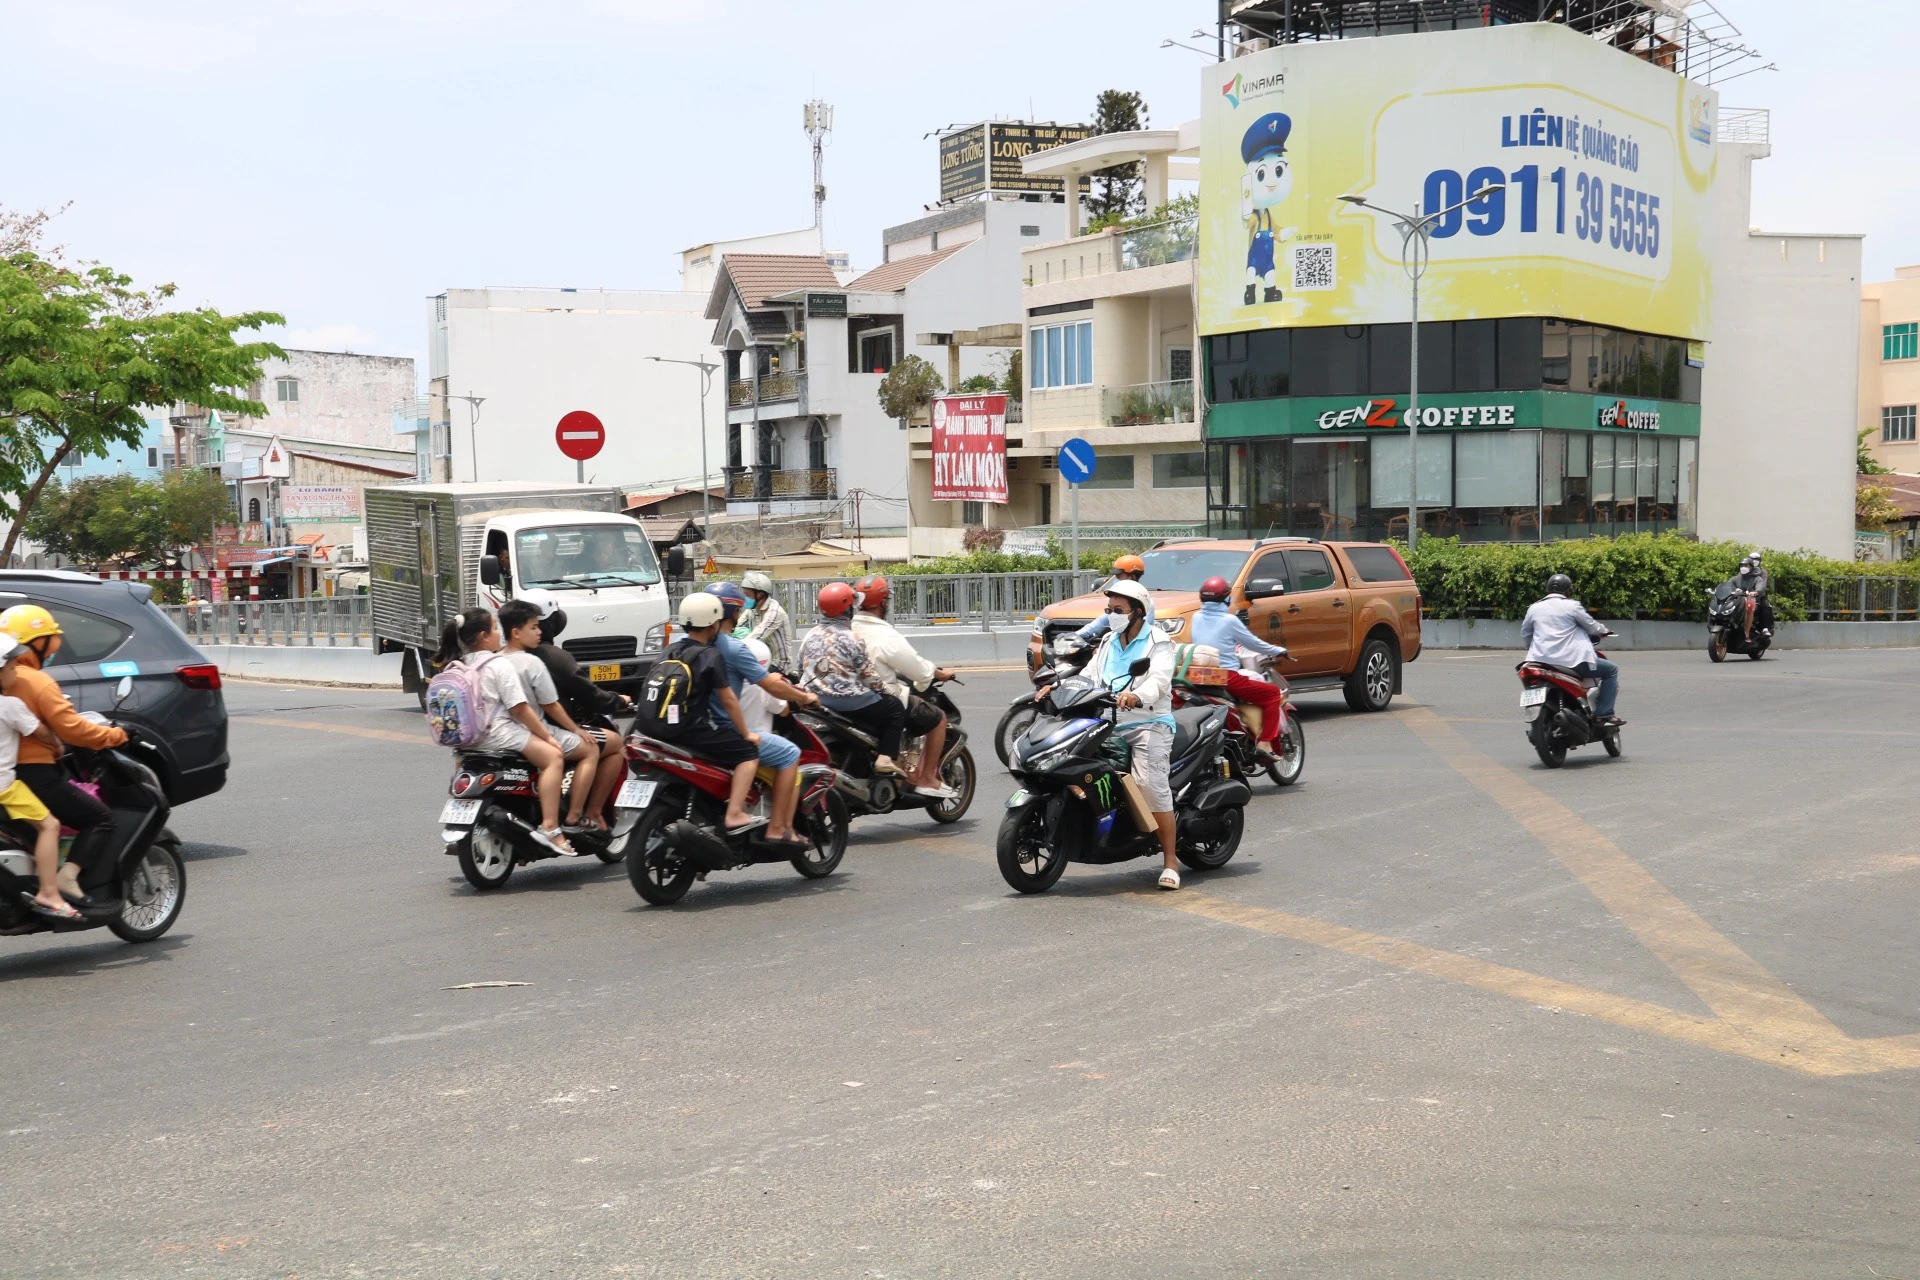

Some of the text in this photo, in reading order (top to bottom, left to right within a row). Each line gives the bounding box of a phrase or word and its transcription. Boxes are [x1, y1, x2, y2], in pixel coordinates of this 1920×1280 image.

[1242, 74, 1284, 94] VINAMA
[993, 140, 1034, 158] LONG
[1502, 107, 1639, 173] LIÊN HỆ QUẢNG CÁO
[942, 150, 960, 170] LONG
[1575, 171, 1604, 244] 39
[1609, 182, 1660, 259] 5555
[974, 399, 986, 409] LÝ
[945, 411, 965, 436] BÁNH
[965, 414, 988, 436] TRUNG
[1403, 405, 1515, 427] COFFEE
[1627, 411, 1660, 430] COFFEE
[951, 441, 974, 487] LÂM
[975, 441, 1005, 488] MÔN
[594, 672, 617, 681] 193.77
[598, 665, 612, 673] 50H
[647, 687, 659, 701] 10
